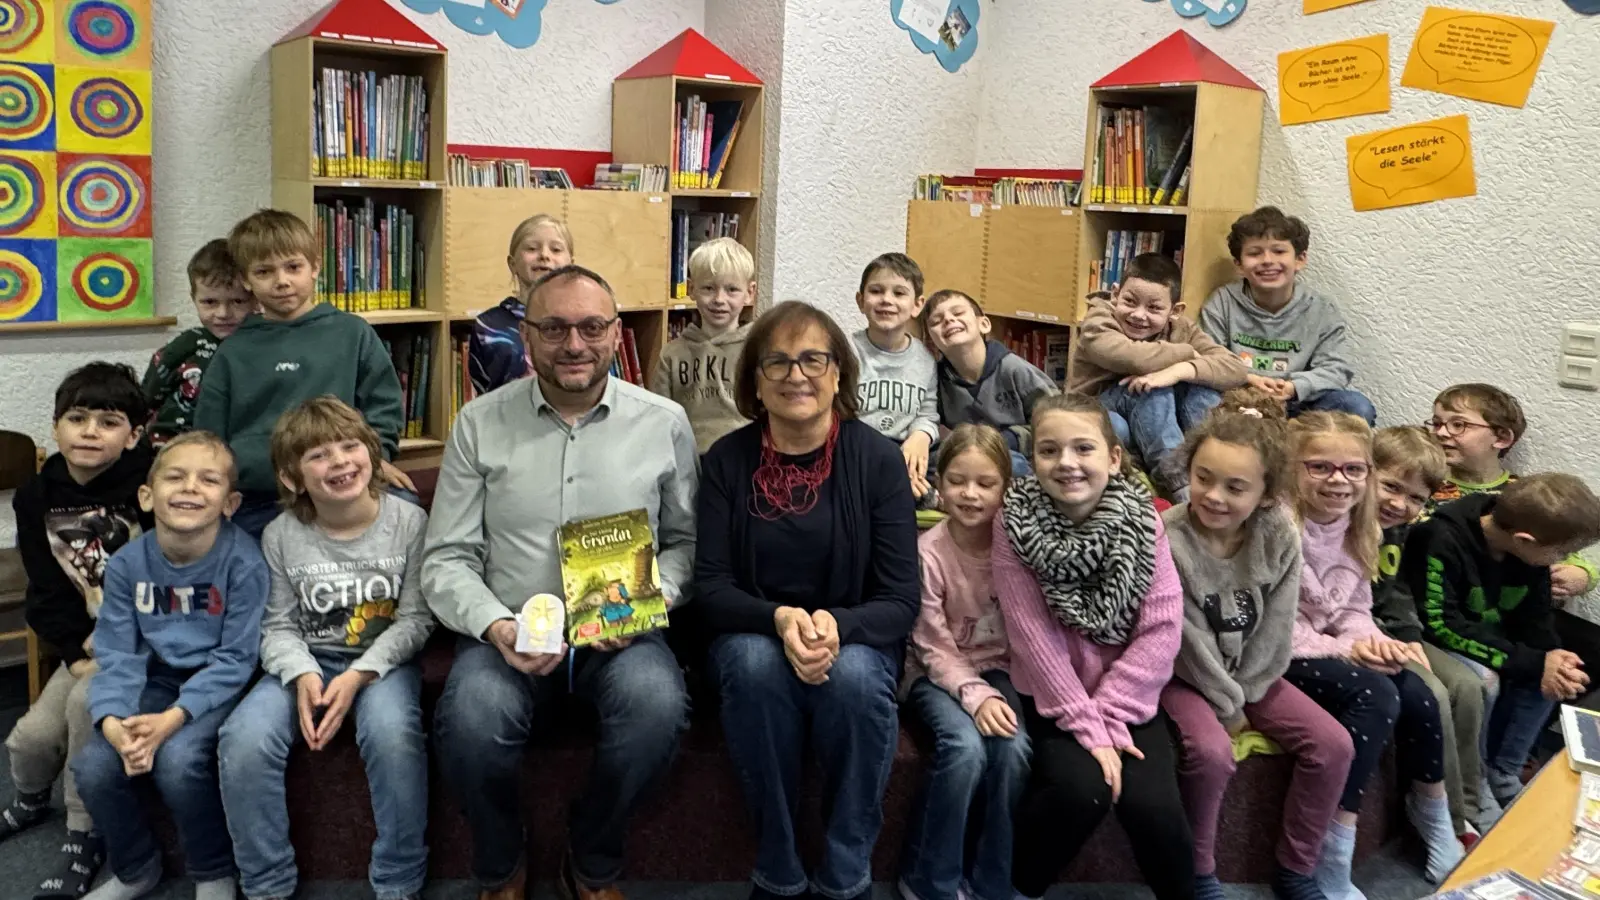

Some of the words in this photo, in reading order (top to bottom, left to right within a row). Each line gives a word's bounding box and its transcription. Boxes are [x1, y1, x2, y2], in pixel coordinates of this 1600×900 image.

[1409, 136, 1445, 149] stärkt
[1379, 158, 1396, 169] die
[341, 559, 376, 572] TRUCK
